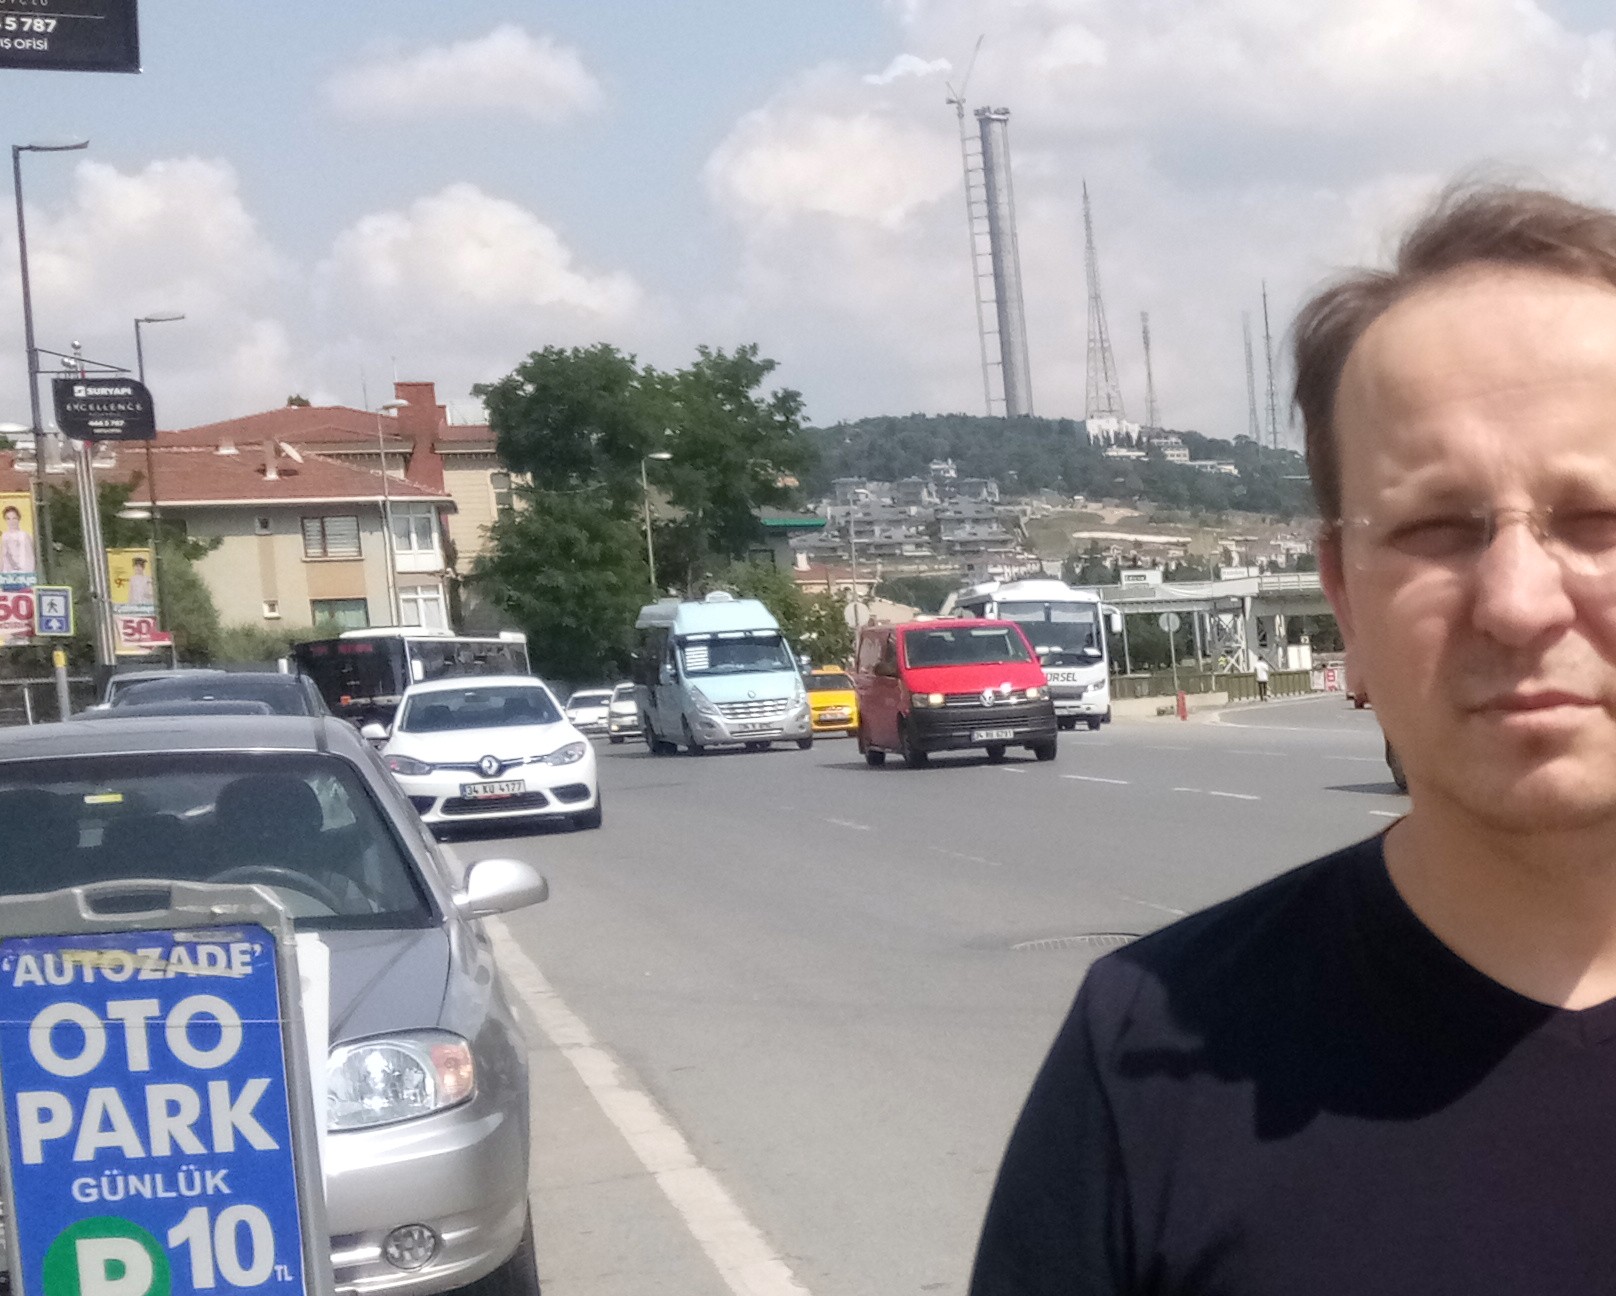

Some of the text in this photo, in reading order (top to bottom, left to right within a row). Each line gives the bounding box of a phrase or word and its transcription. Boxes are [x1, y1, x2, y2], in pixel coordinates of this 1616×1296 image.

[14, 38, 48, 50] OFİSİ
[20, 18, 57, 33] 787
[28, 994, 244, 1078] OTO
[16, 1078, 281, 1165] PARK
[71, 1164, 233, 1203] GÜNLÜK
[167, 1203, 276, 1290] 10
[274, 1264, 294, 1283] TL
